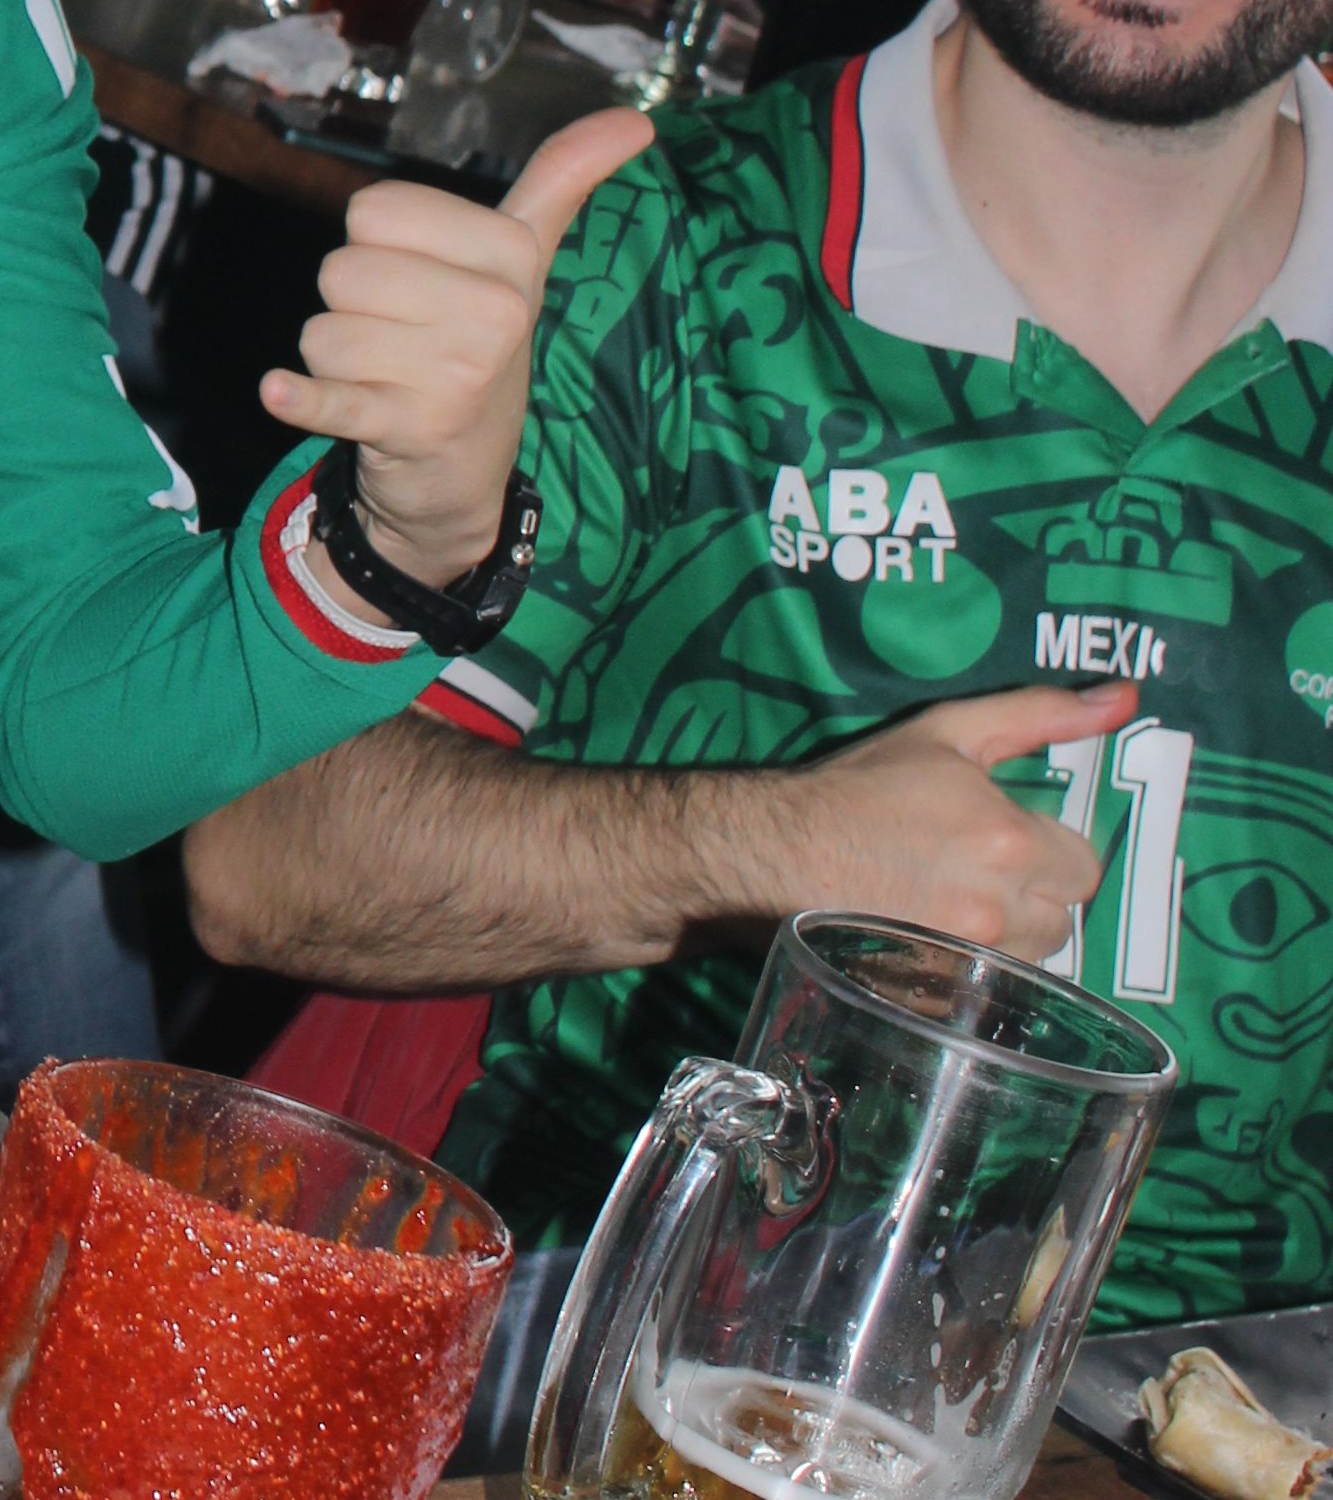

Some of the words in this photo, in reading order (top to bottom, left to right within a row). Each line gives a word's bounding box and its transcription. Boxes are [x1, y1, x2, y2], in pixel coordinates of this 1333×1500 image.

[768, 465, 957, 538] ABA
[768, 522, 958, 584] SPORT
[1040, 716, 1195, 1005] 11
